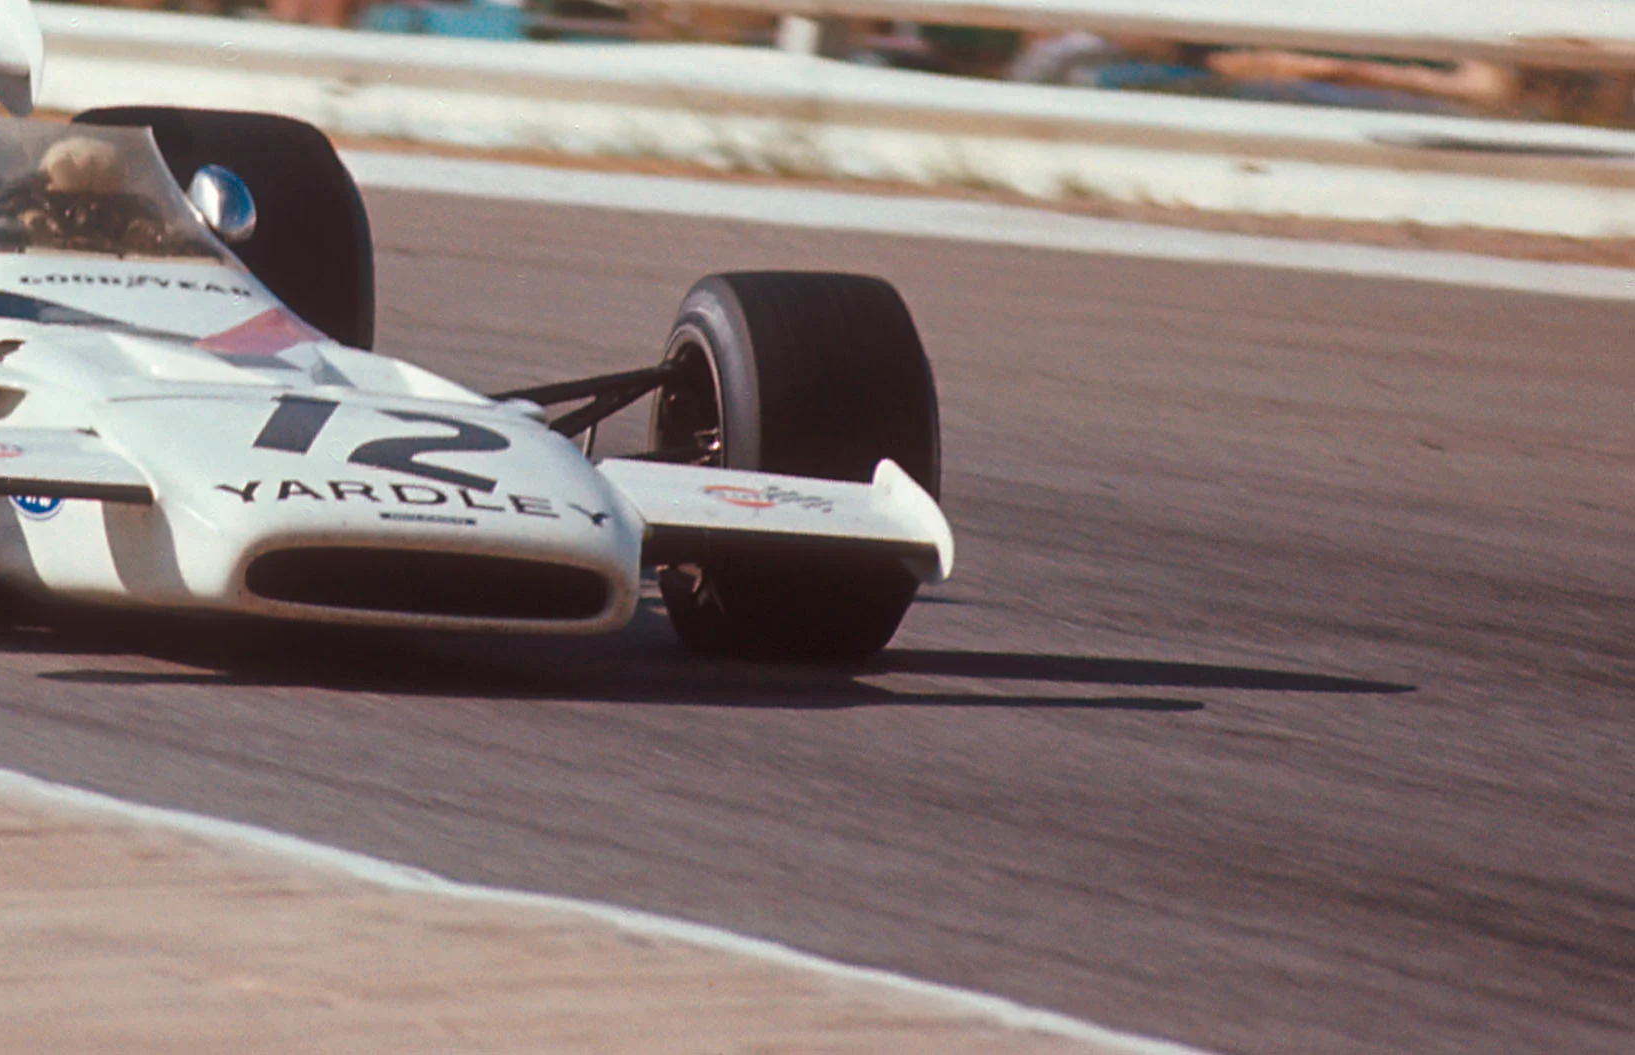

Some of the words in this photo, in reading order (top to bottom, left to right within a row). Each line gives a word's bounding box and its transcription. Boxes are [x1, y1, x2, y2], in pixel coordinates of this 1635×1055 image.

[19, 273, 253, 298] GOODYEAR
[252, 393, 511, 494] 12
[213, 478, 611, 528] YARDLEY
